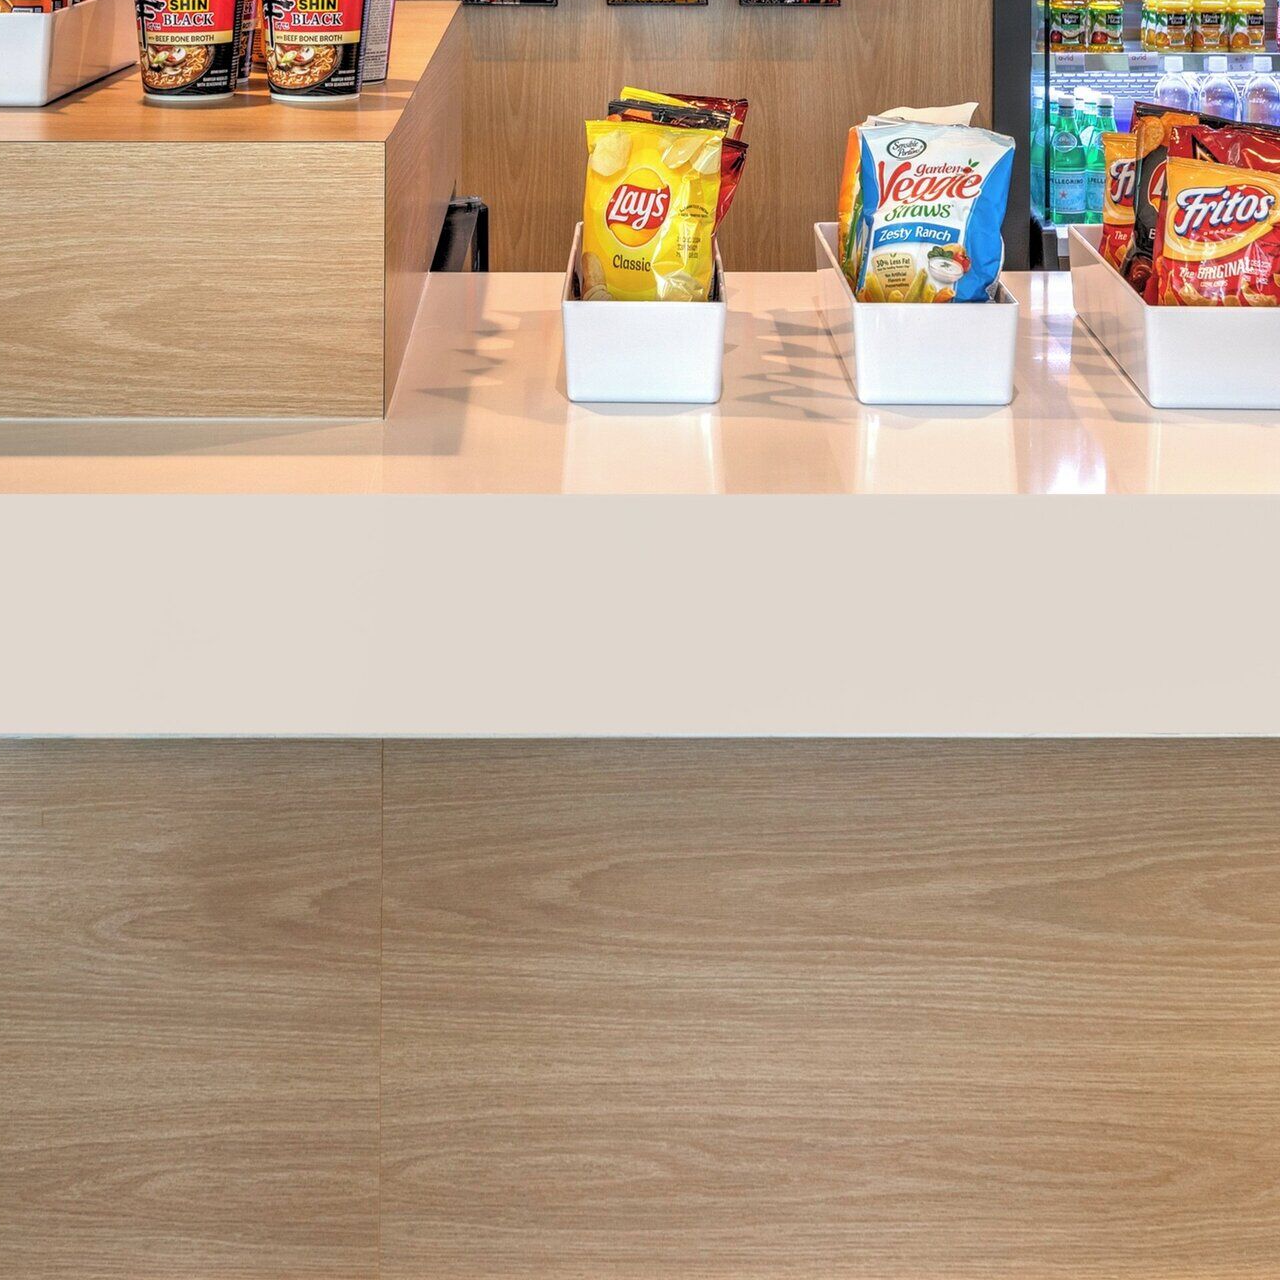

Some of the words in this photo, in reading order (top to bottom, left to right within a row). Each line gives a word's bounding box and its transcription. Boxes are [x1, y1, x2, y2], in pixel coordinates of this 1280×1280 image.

[169, 0, 208, 11] SHIN
[163, 13, 214, 26] BLACK
[292, 13, 343, 26] BLACK
[155, 35, 170, 43] BEEF
[171, 35, 191, 43] BONE
[191, 34, 215, 42] BROTH
[283, 35, 298, 43] BEEF
[299, 35, 319, 43] BONE
[319, 34, 343, 42] BROTH
[914, 162, 961, 177] garden
[878, 161, 982, 209] Veggie
[608, 184, 669, 230] Lay's
[1174, 185, 1276, 238] Fritos
[878, 227, 913, 243] Zesty
[915, 226, 952, 242] Ranch
[1114, 230, 1128, 240] The
[612, 254, 651, 272] Classic
[1179, 266, 1195, 278] The
[1197, 256, 1253, 279] ORIGINAL
